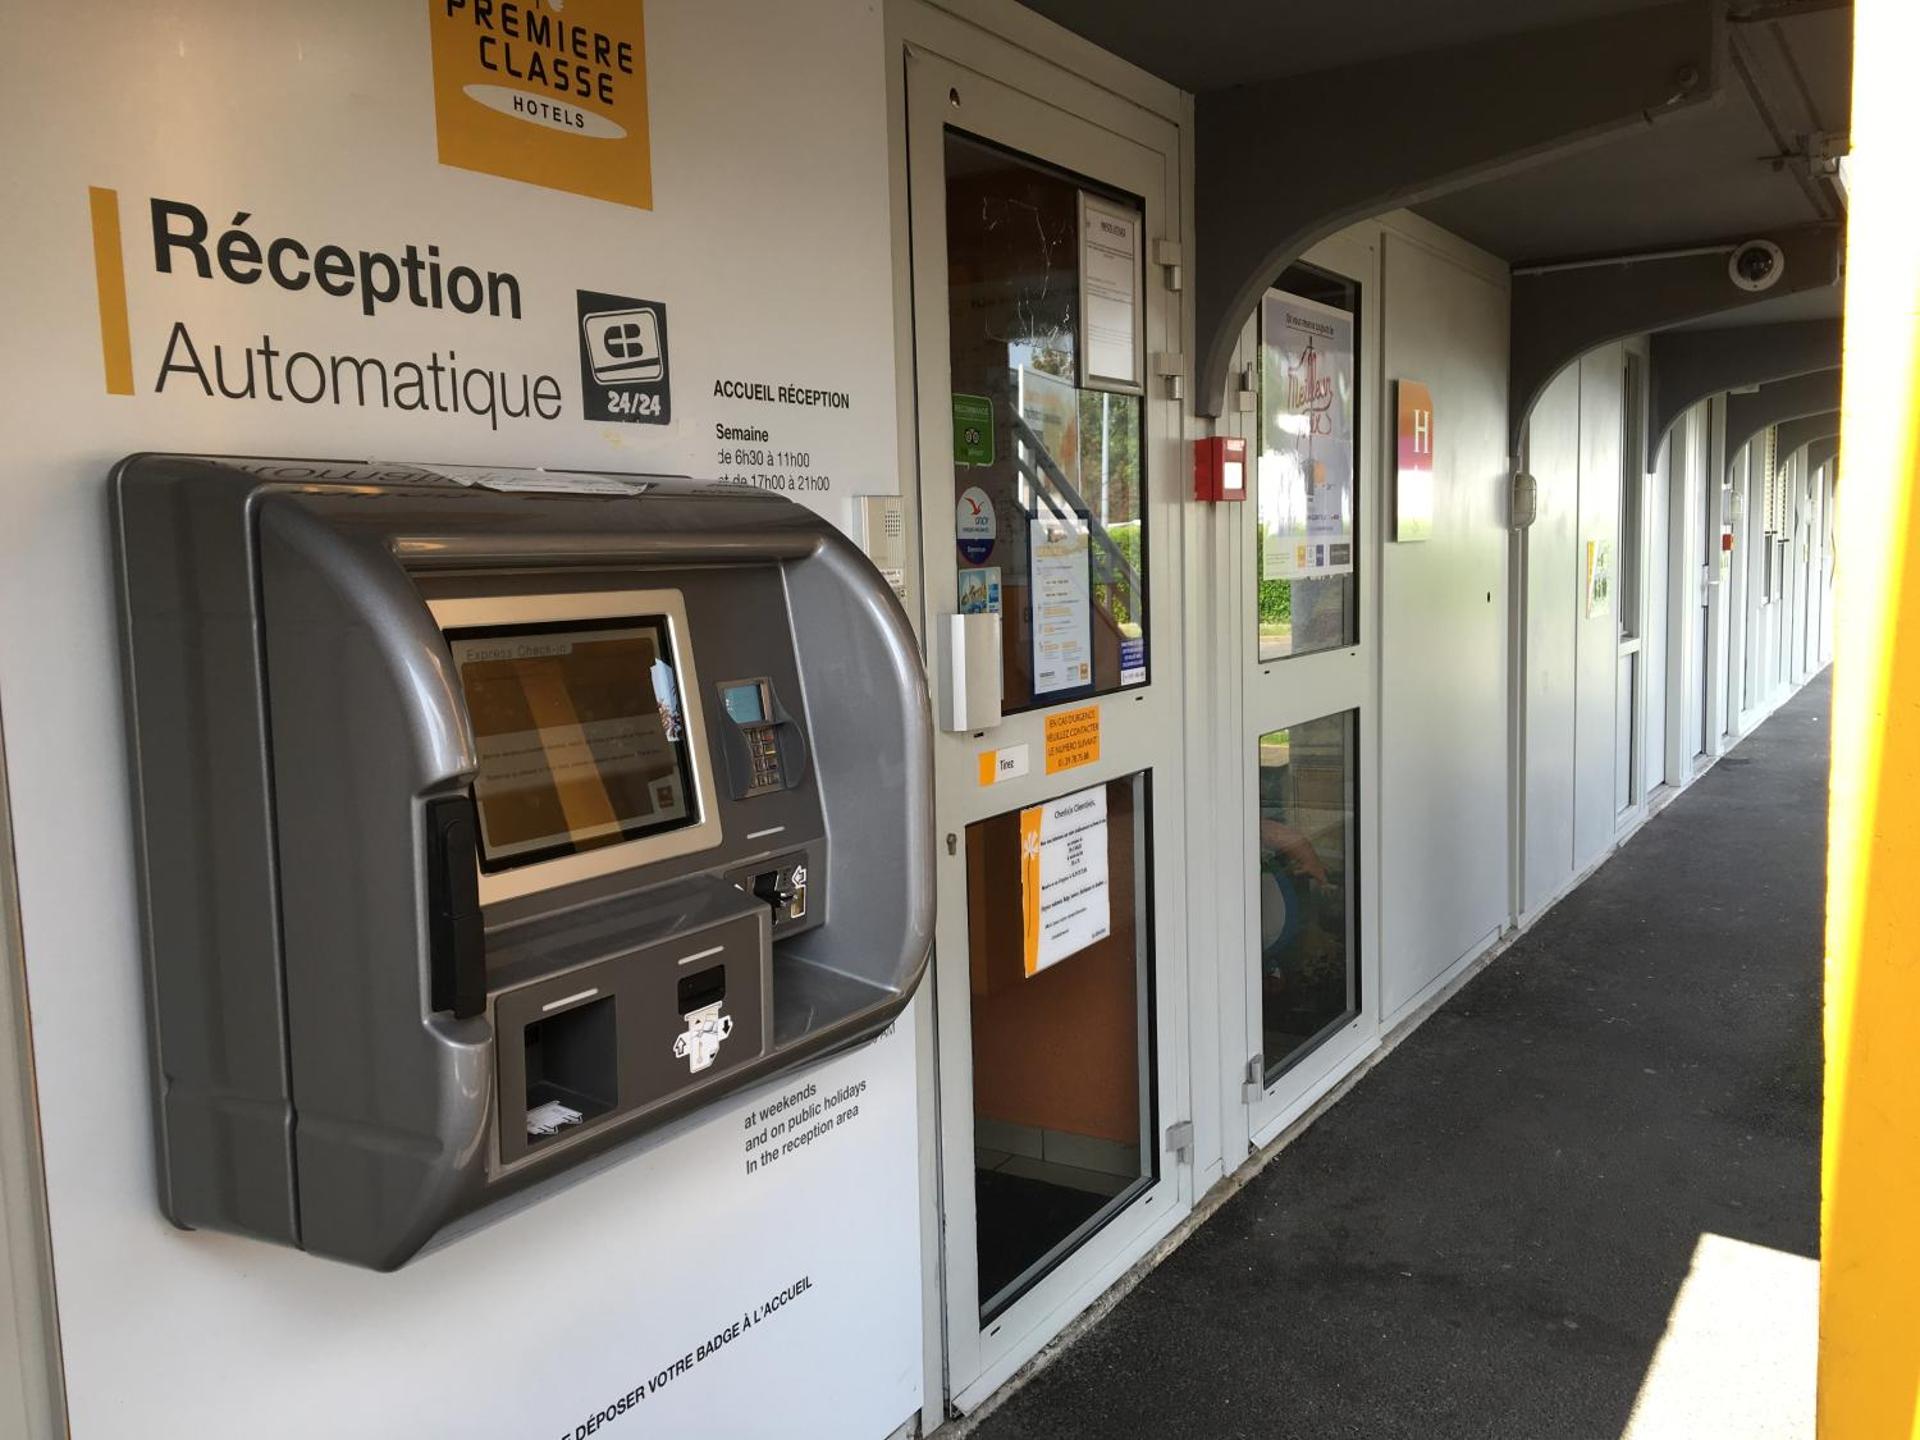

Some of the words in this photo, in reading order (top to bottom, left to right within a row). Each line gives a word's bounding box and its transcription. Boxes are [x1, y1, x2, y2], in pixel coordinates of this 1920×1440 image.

[447, 0, 633, 74] PREMIERE
[479, 35, 614, 105] CLASSE
[513, 96, 586, 129] HOTELS
[149, 197, 522, 320] Réception
[154, 321, 562, 431] Automatique
[713, 379, 775, 402] ACCUEIL
[778, 383, 850, 409] RÉCEPTION
[606, 389, 662, 417] 24/24
[716, 423, 769, 442] Semaine
[1413, 409, 1430, 454] H
[718, 449, 732, 465] de
[735, 449, 764, 466] 6h30
[767, 450, 774, 466] à
[777, 452, 810, 467] 11h00
[732, 473, 747, 485] de
[751, 474, 785, 490] 17h00
[788, 475, 795, 490] à
[797, 476, 830, 491] 21h00
[744, 1109, 757, 1129] at
[759, 1083, 817, 1120] weekends
[745, 1132, 769, 1152] and
[770, 1127, 786, 1141] on
[787, 1103, 821, 1134] public
[823, 1080, 867, 1110] holidays
[746, 1158, 758, 1175] In
[760, 1146, 780, 1168] the
[782, 1119, 833, 1151] reception
[836, 1105, 859, 1127] area
[574, 1385, 645, 1440] DÉPOSER
[648, 1353, 693, 1393] VOTRE
[696, 1322, 741, 1362] BADGE
[742, 1312, 752, 1332] À
[753, 1275, 813, 1325] L'ACCUEIL
